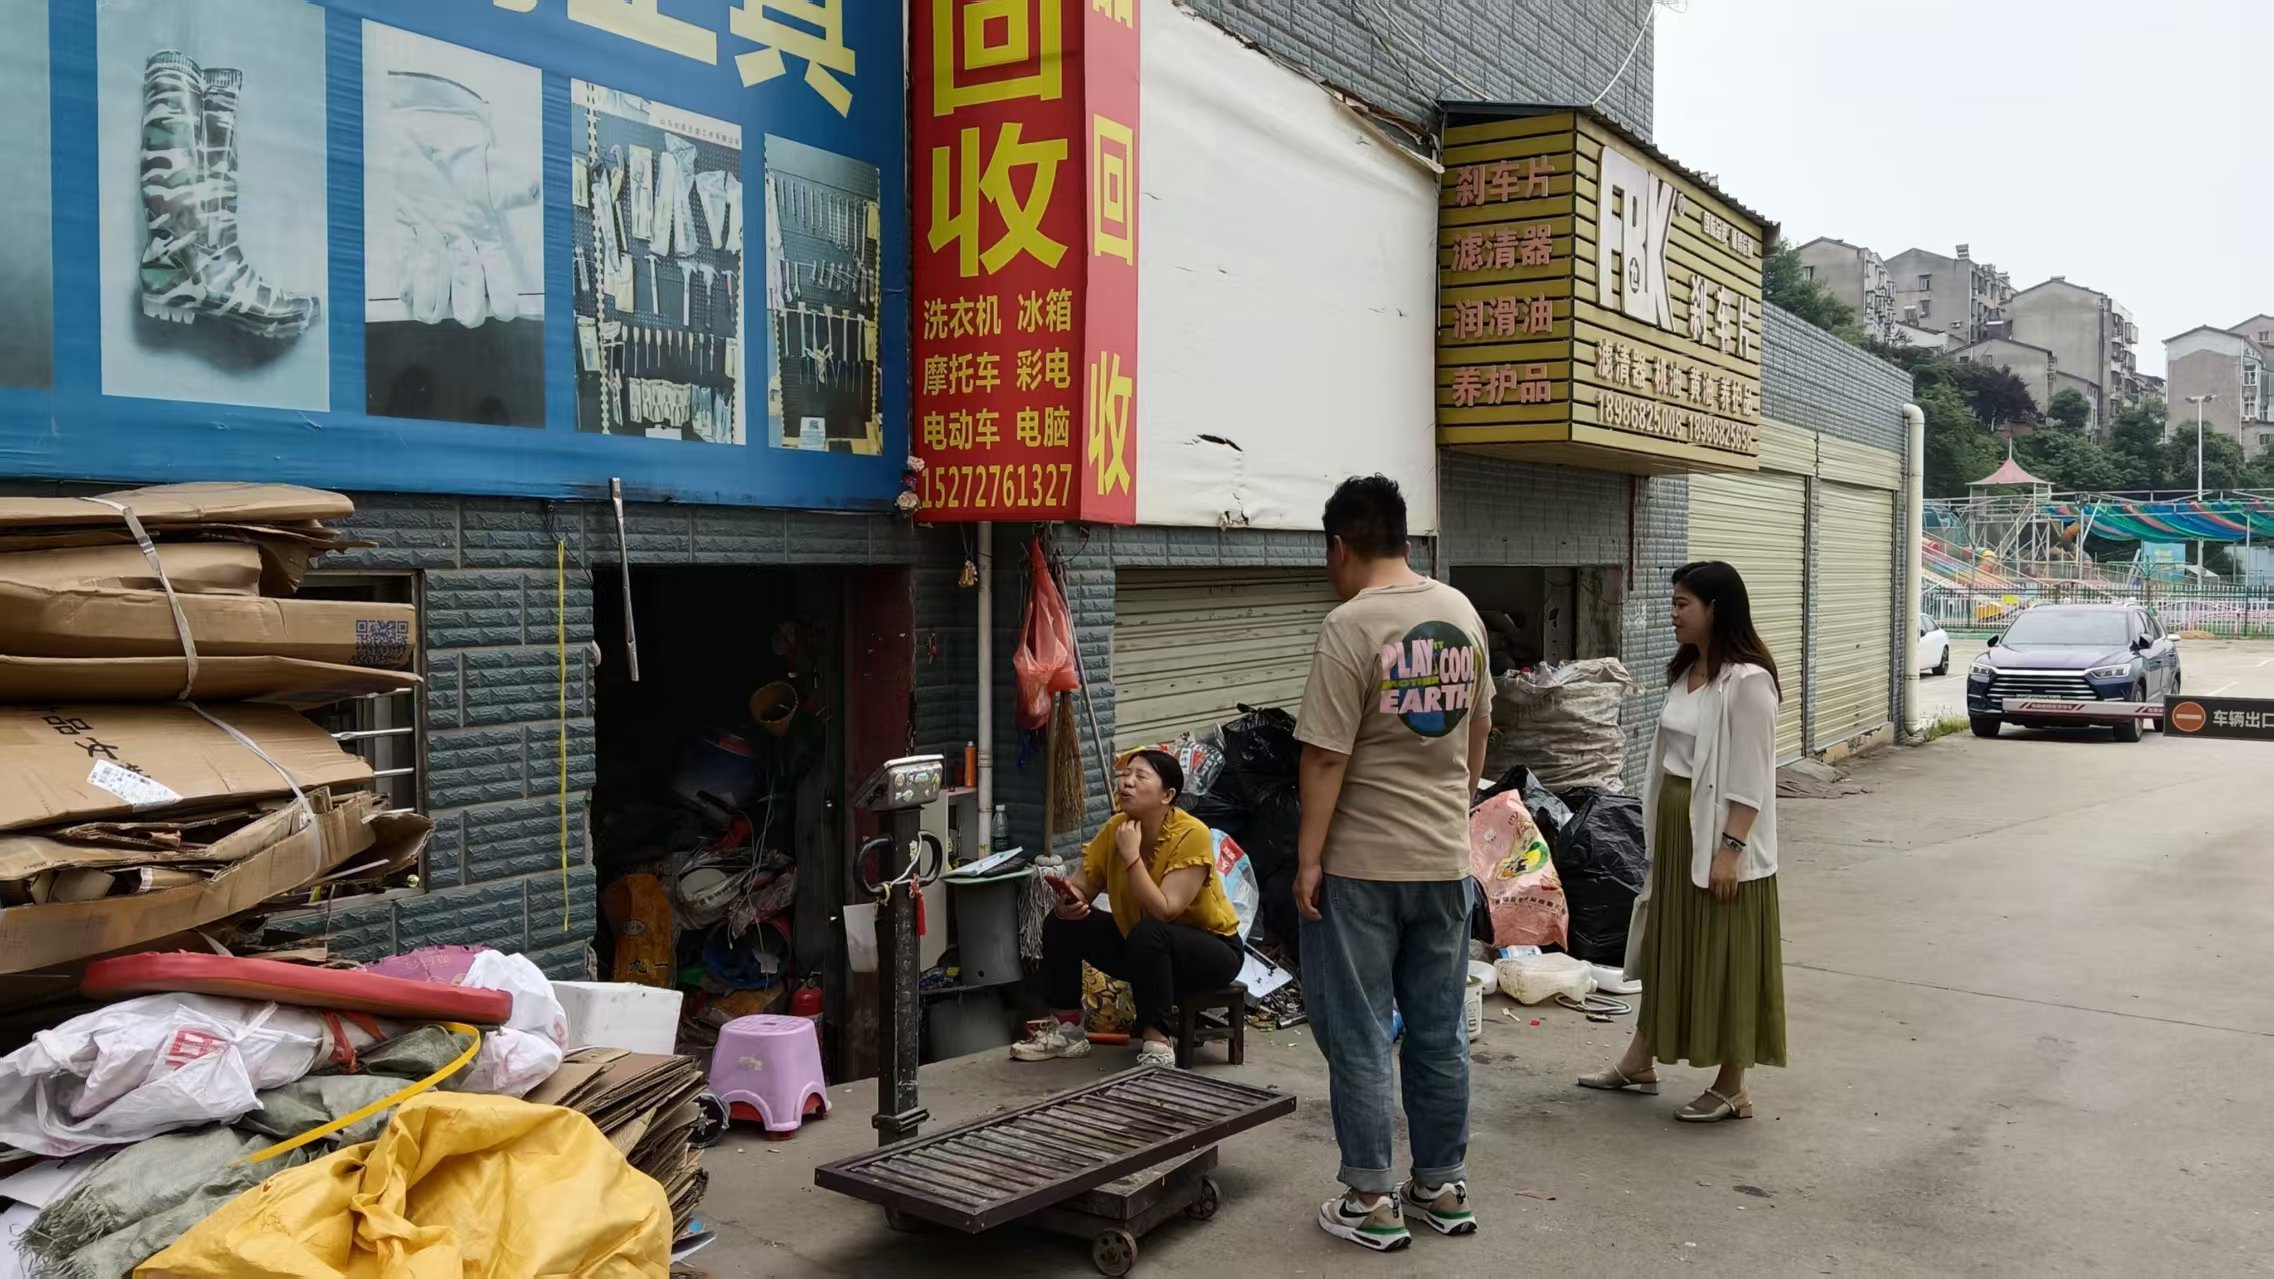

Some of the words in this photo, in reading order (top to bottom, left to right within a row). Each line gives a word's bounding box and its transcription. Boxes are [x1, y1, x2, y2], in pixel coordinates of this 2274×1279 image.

[1456, 155, 1555, 206] 刹车片
[1089, 0, 1134, 496] 回收
[1451, 224, 1552, 271] 滤清器
[1599, 145, 1677, 332] FBK
[923, 294, 1001, 340] 洗衣机
[1017, 287, 1073, 333] 冰箱
[1454, 292, 1552, 339] 润滑油
[1688, 273, 1751, 360] 刹车片
[923, 352, 1001, 396] 摩托车
[1016, 346, 1072, 392] 彩电
[1452, 363, 1552, 407] 养护品
[1596, 338, 1646, 388] 滤清器
[1654, 356, 1683, 398] 机油
[1688, 366, 1714, 407] 黄油
[1719, 376, 1753, 417] 养护品
[923, 408, 1001, 451] 电动车
[1016, 404, 1071, 448] 电脑
[921, 463, 1073, 509] 15272761327
[1381, 639, 1434, 680] PLAY
[1379, 684, 1471, 714] EARTH
[2212, 709, 2274, 728] 车辆出口
